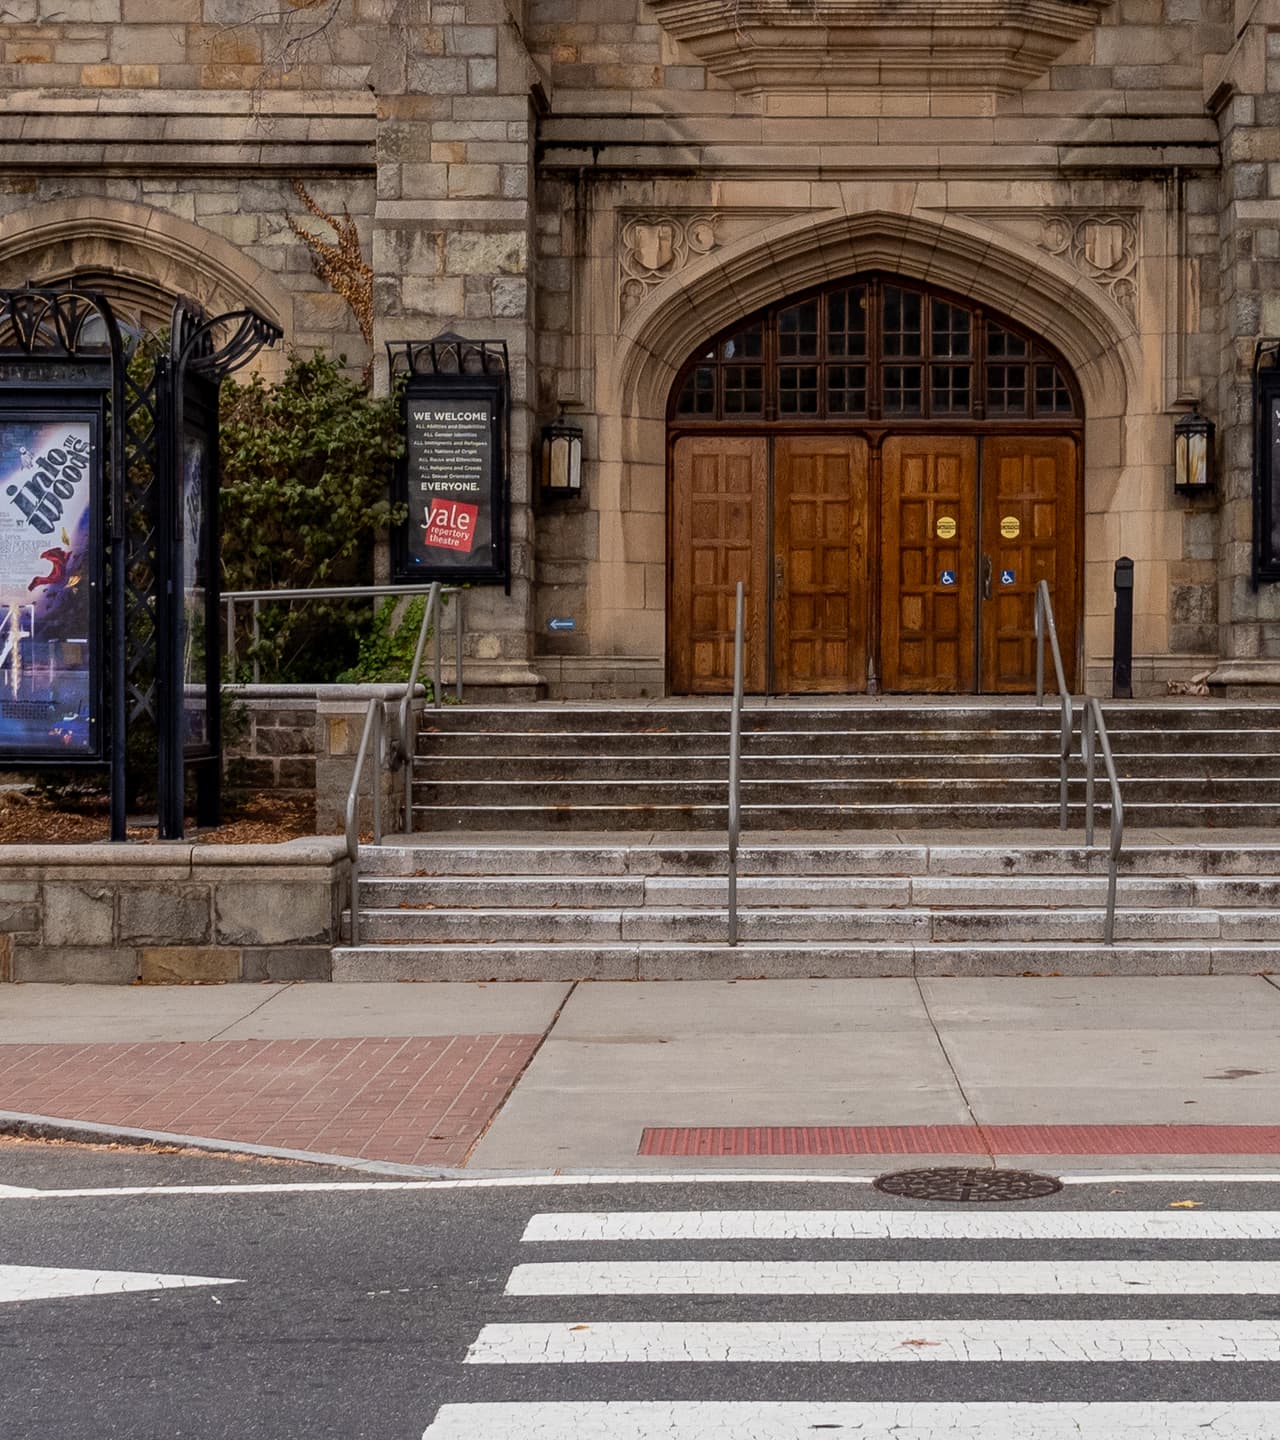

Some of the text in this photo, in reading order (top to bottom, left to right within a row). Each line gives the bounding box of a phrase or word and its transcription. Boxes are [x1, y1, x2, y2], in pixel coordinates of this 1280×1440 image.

[414, 412, 487, 420] WE WELCOME
[421, 482, 480, 490] EVERYONE.
[420, 504, 470, 530] yale
[431, 526, 470, 541] repertory
[430, 534, 460, 546] theatre
